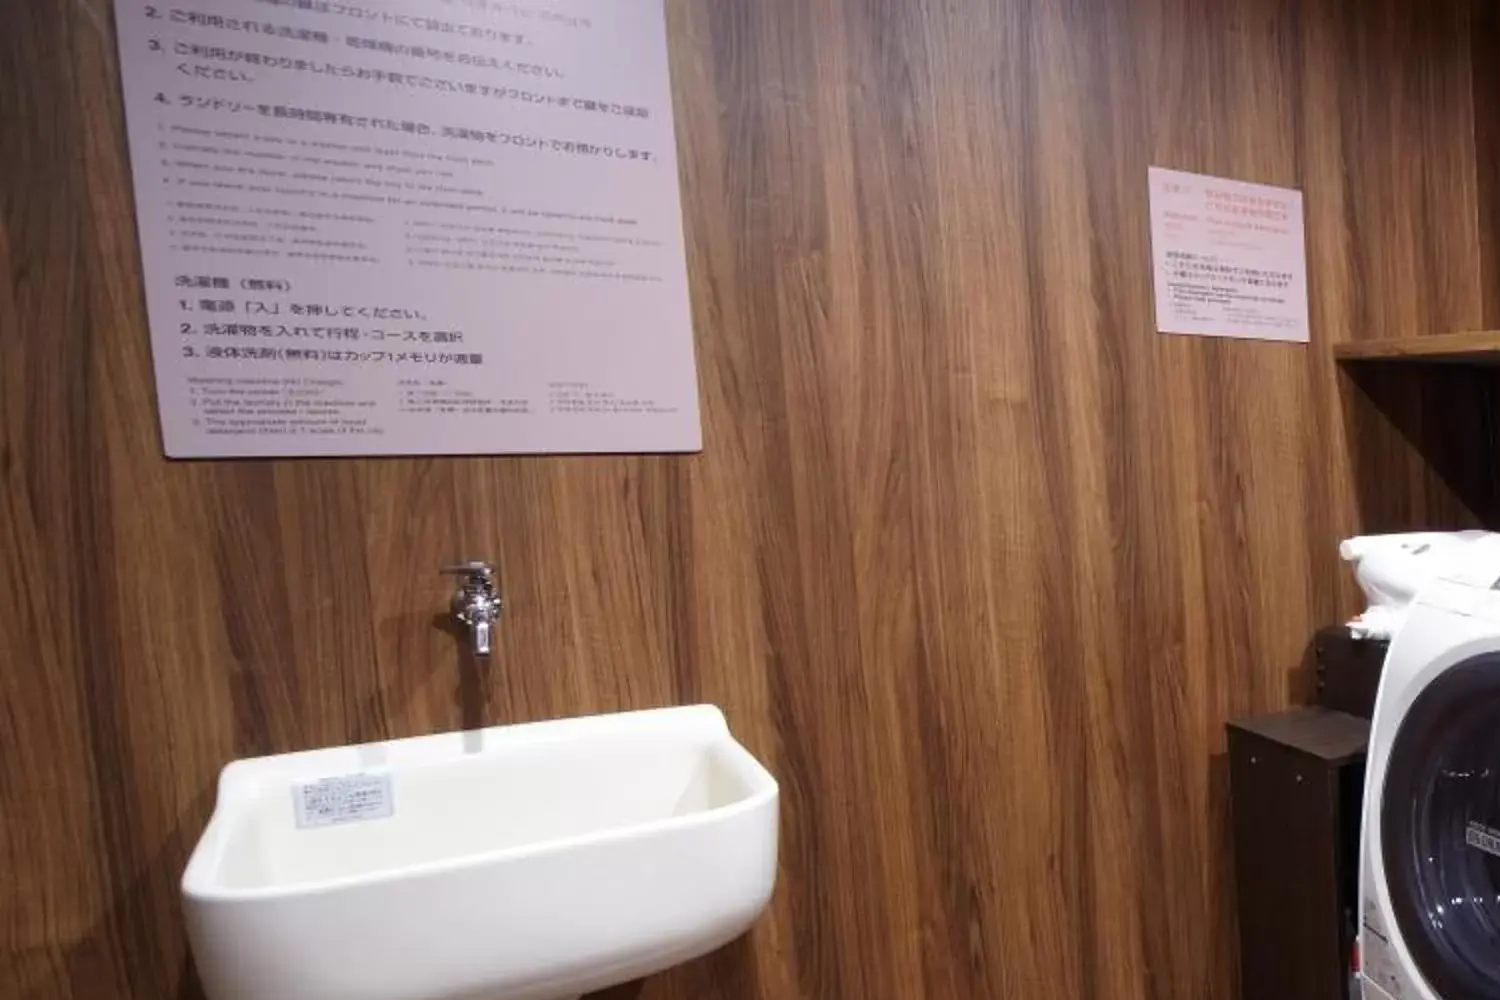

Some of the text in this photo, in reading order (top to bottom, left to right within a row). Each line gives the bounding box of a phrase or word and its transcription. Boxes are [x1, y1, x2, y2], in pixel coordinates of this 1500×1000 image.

[144, 5, 162, 19] 2.
[147, 39, 165, 55] 3.
[154, 92, 171, 105] 4.
[179, 300, 193, 312] 1.
[180, 323, 197, 335] 2.
[182, 347, 199, 359] 3.
